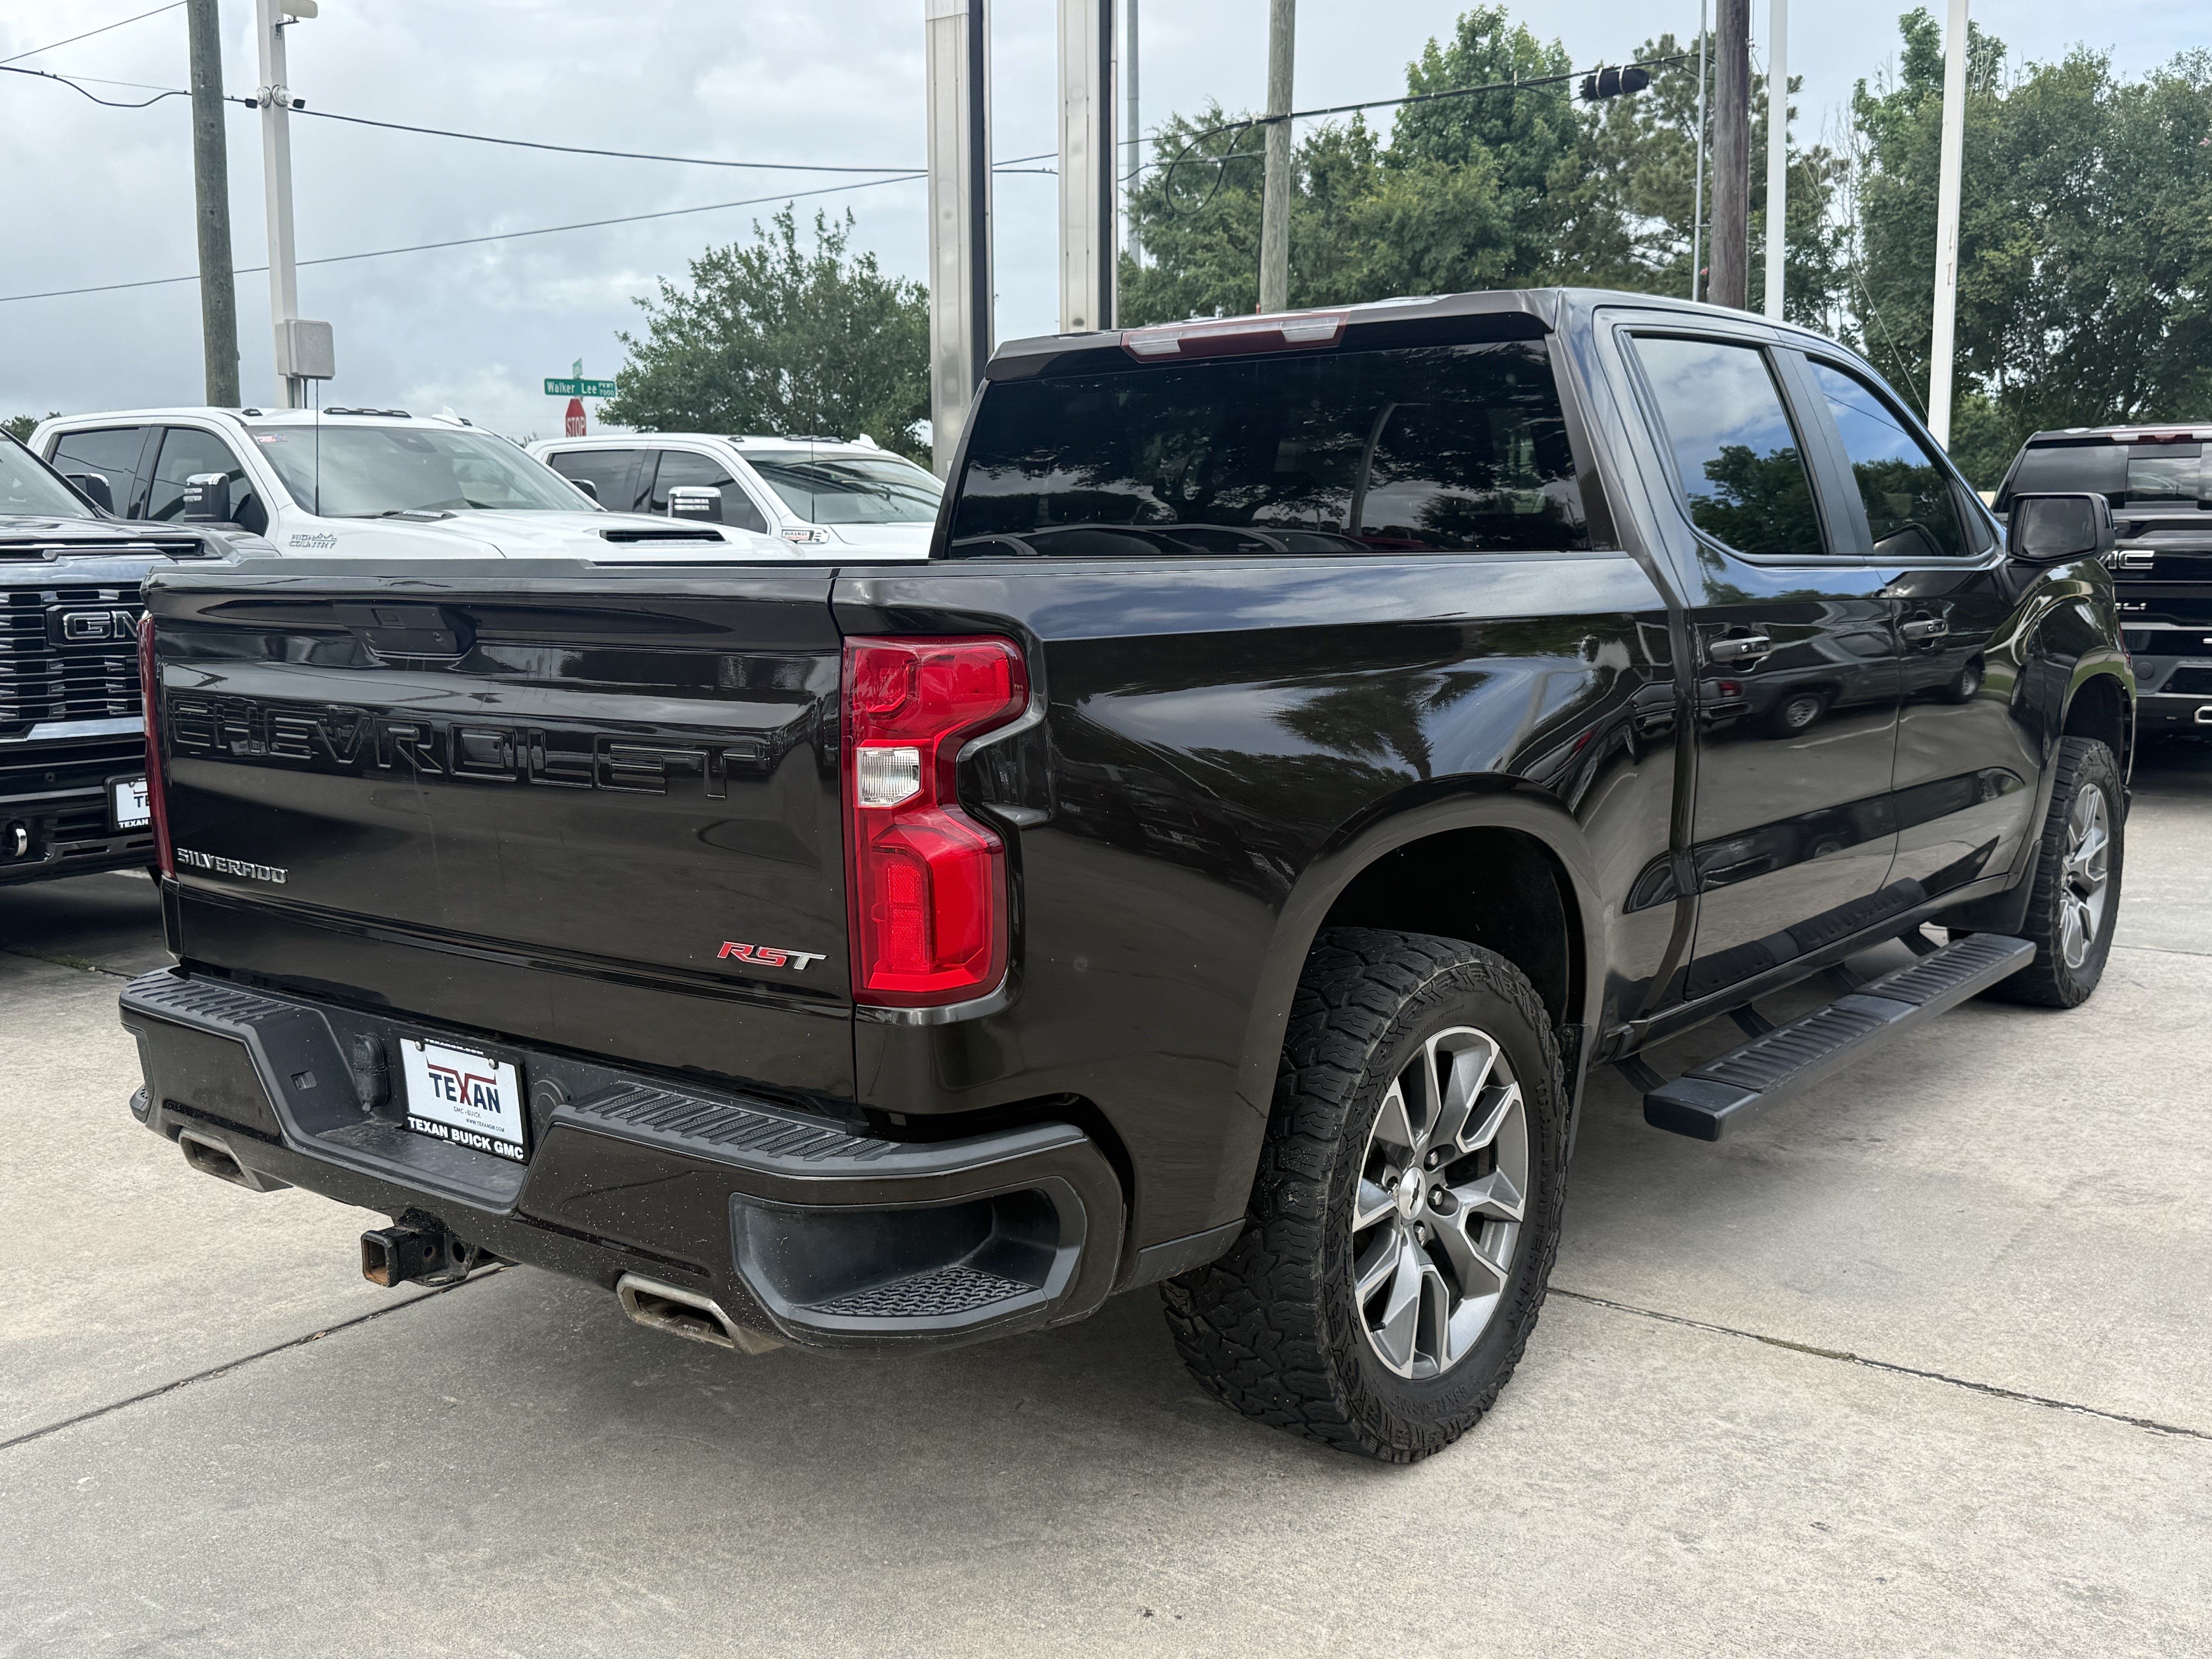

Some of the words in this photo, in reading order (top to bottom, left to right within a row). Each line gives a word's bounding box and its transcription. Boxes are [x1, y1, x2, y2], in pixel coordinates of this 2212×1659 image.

[547, 381, 575, 393] Walker
[582, 383, 597, 394] Lee
[567, 417, 585, 437] STOP
[172, 699, 758, 799] CHEVROLET
[118, 818, 149, 828] TEXAN
[177, 848, 288, 884] SILVERADO
[717, 941, 828, 970] RST
[427, 1063, 501, 1114] TEXAN
[408, 1116, 448, 1138] TEXAN
[451, 1128, 491, 1150] BUICK
[494, 1140, 524, 1159] GMC
